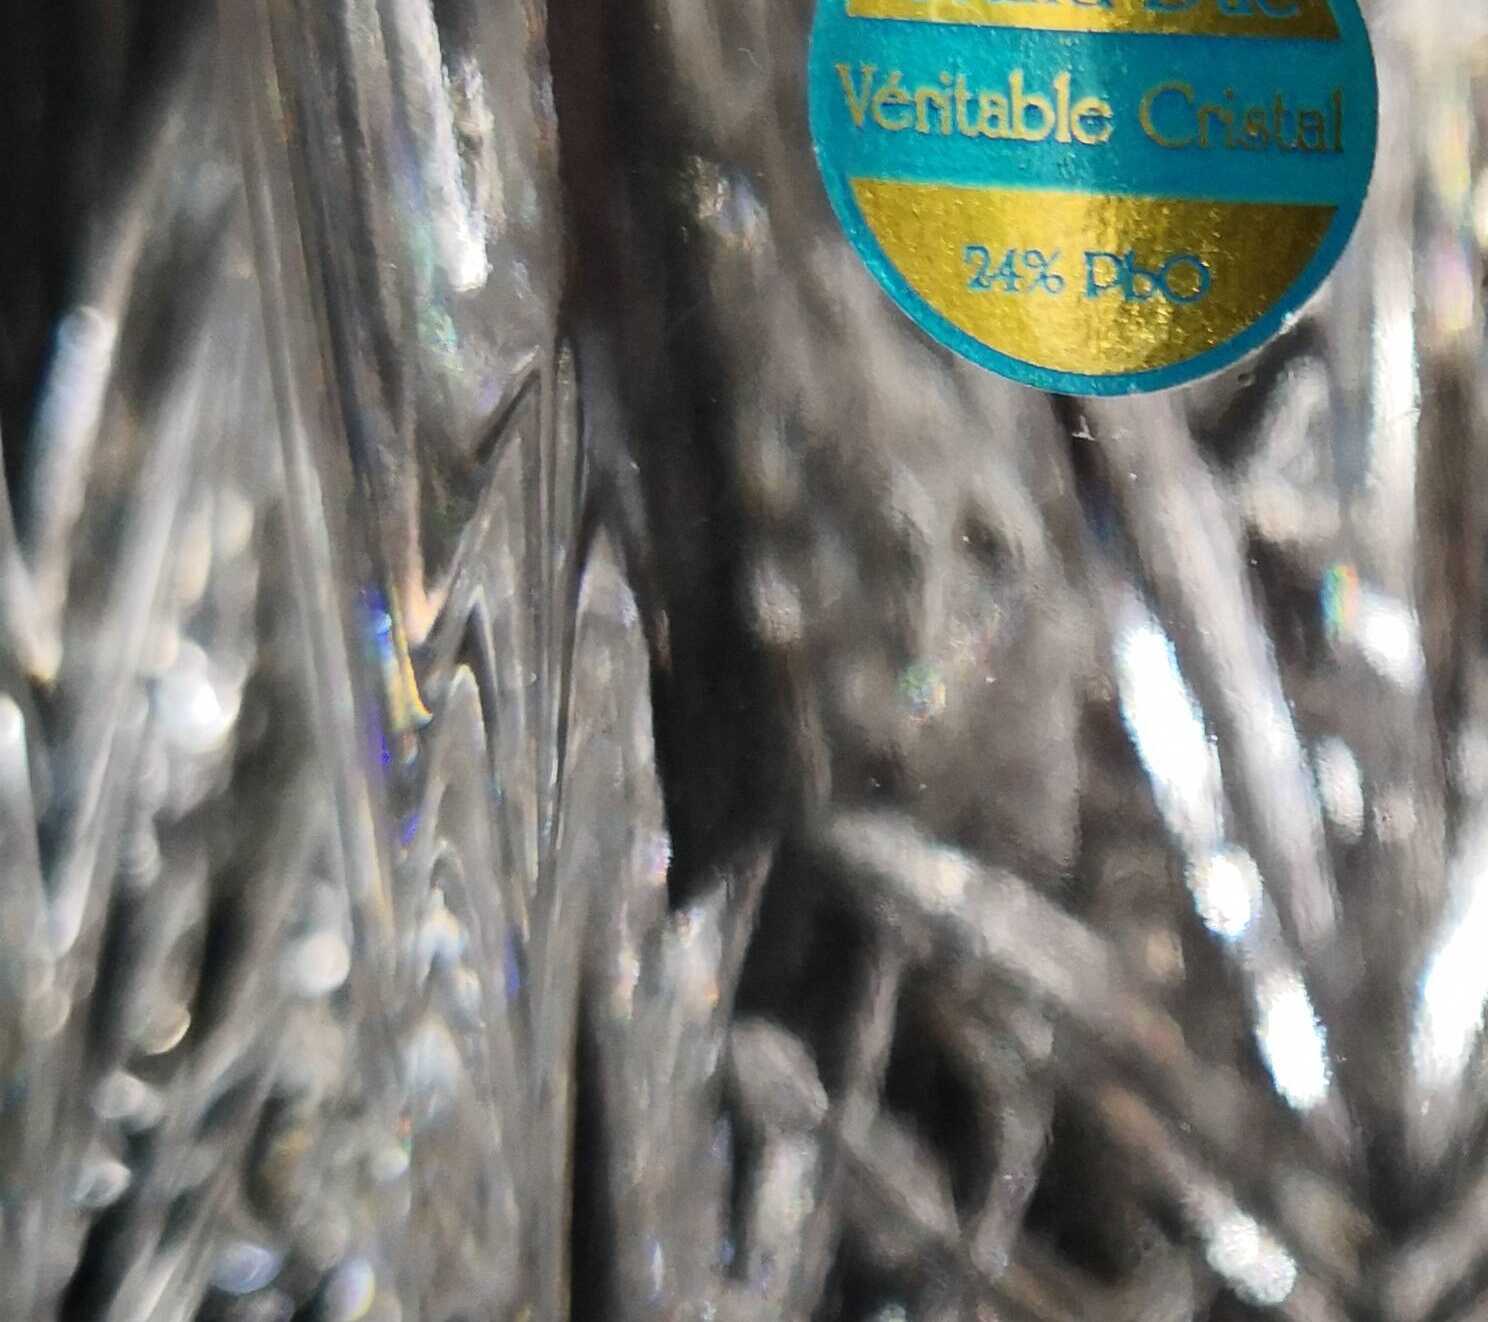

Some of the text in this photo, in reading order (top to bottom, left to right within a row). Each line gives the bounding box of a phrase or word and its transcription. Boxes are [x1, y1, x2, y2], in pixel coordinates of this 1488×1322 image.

[835, 63, 1344, 154] Véritable Cristal
[963, 245, 1211, 304] 24% PbO
